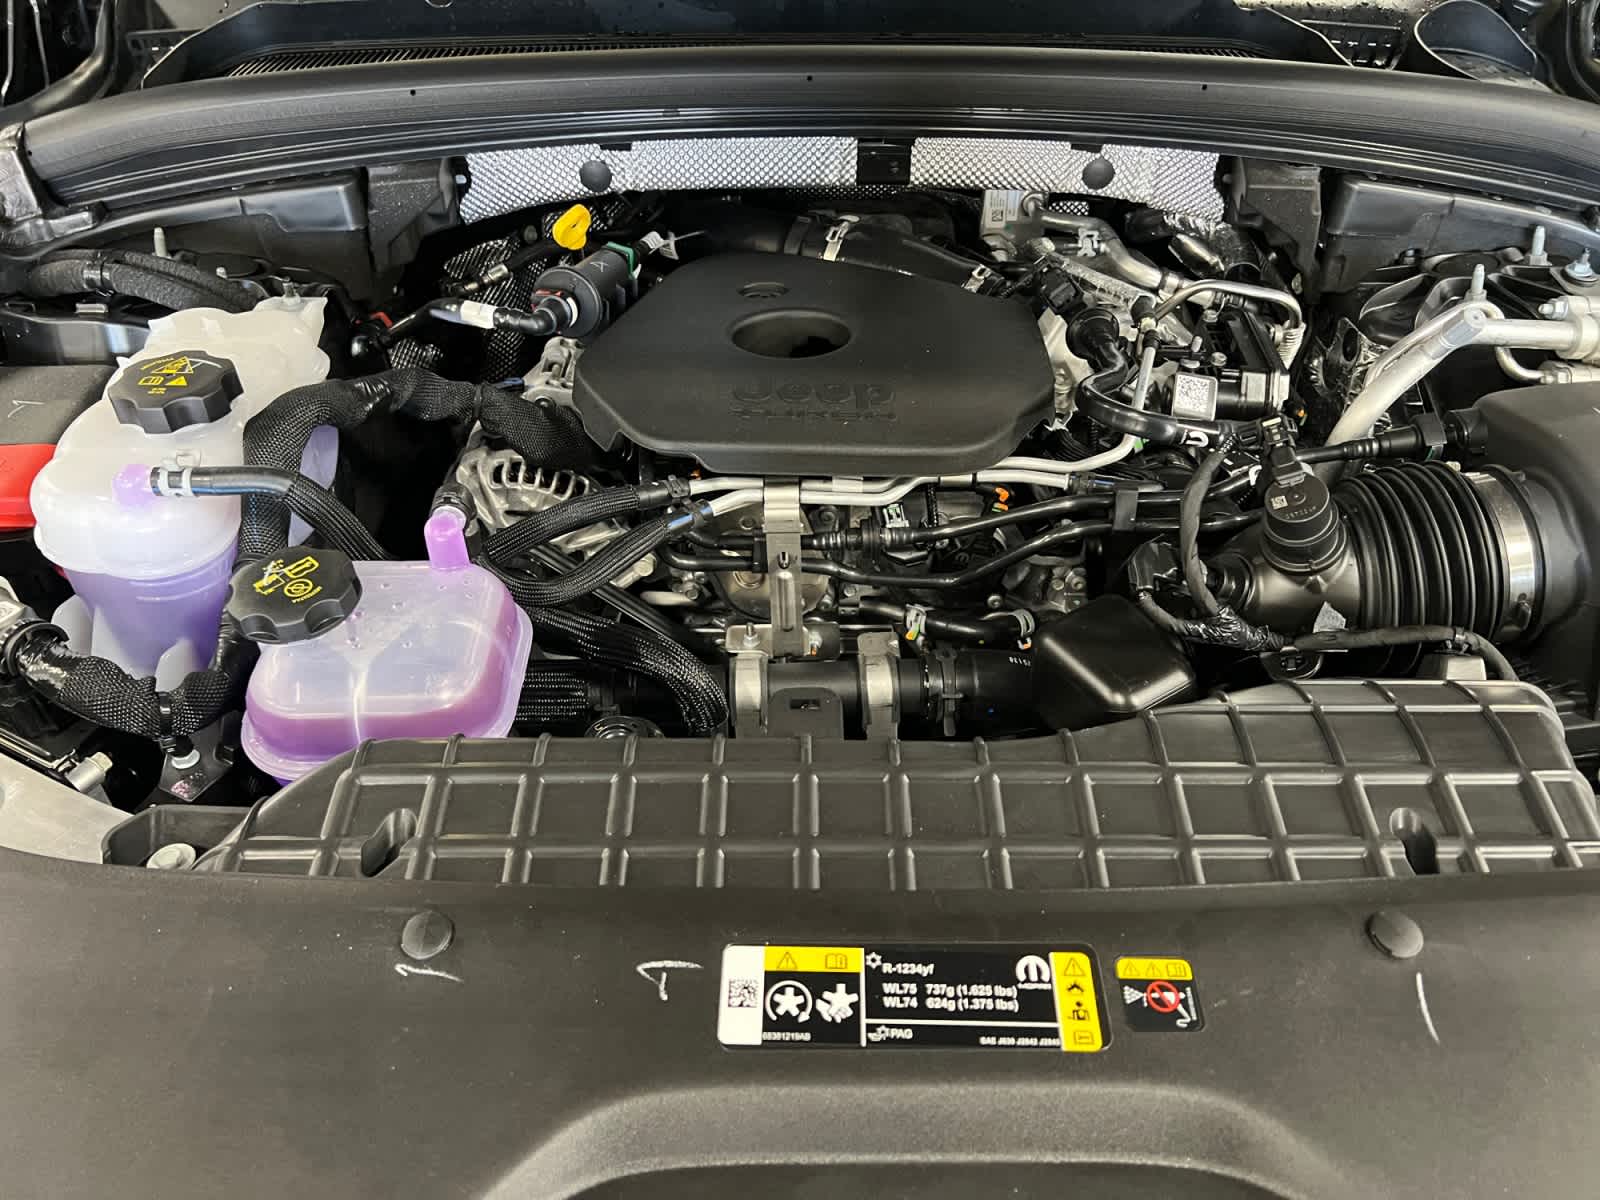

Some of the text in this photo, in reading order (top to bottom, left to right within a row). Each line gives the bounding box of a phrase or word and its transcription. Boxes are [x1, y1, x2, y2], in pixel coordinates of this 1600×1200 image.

[882, 963, 935, 977] R-1234yf
[882, 982, 918, 995] WL75
[924, 983, 955, 998] 737g
[956, 984, 993, 997] (1.625
[993, 985, 1018, 999] lbs)
[882, 996, 1019, 1013] WL74 624g (1.375 lbs)
[890, 1027, 914, 1040] PAG
